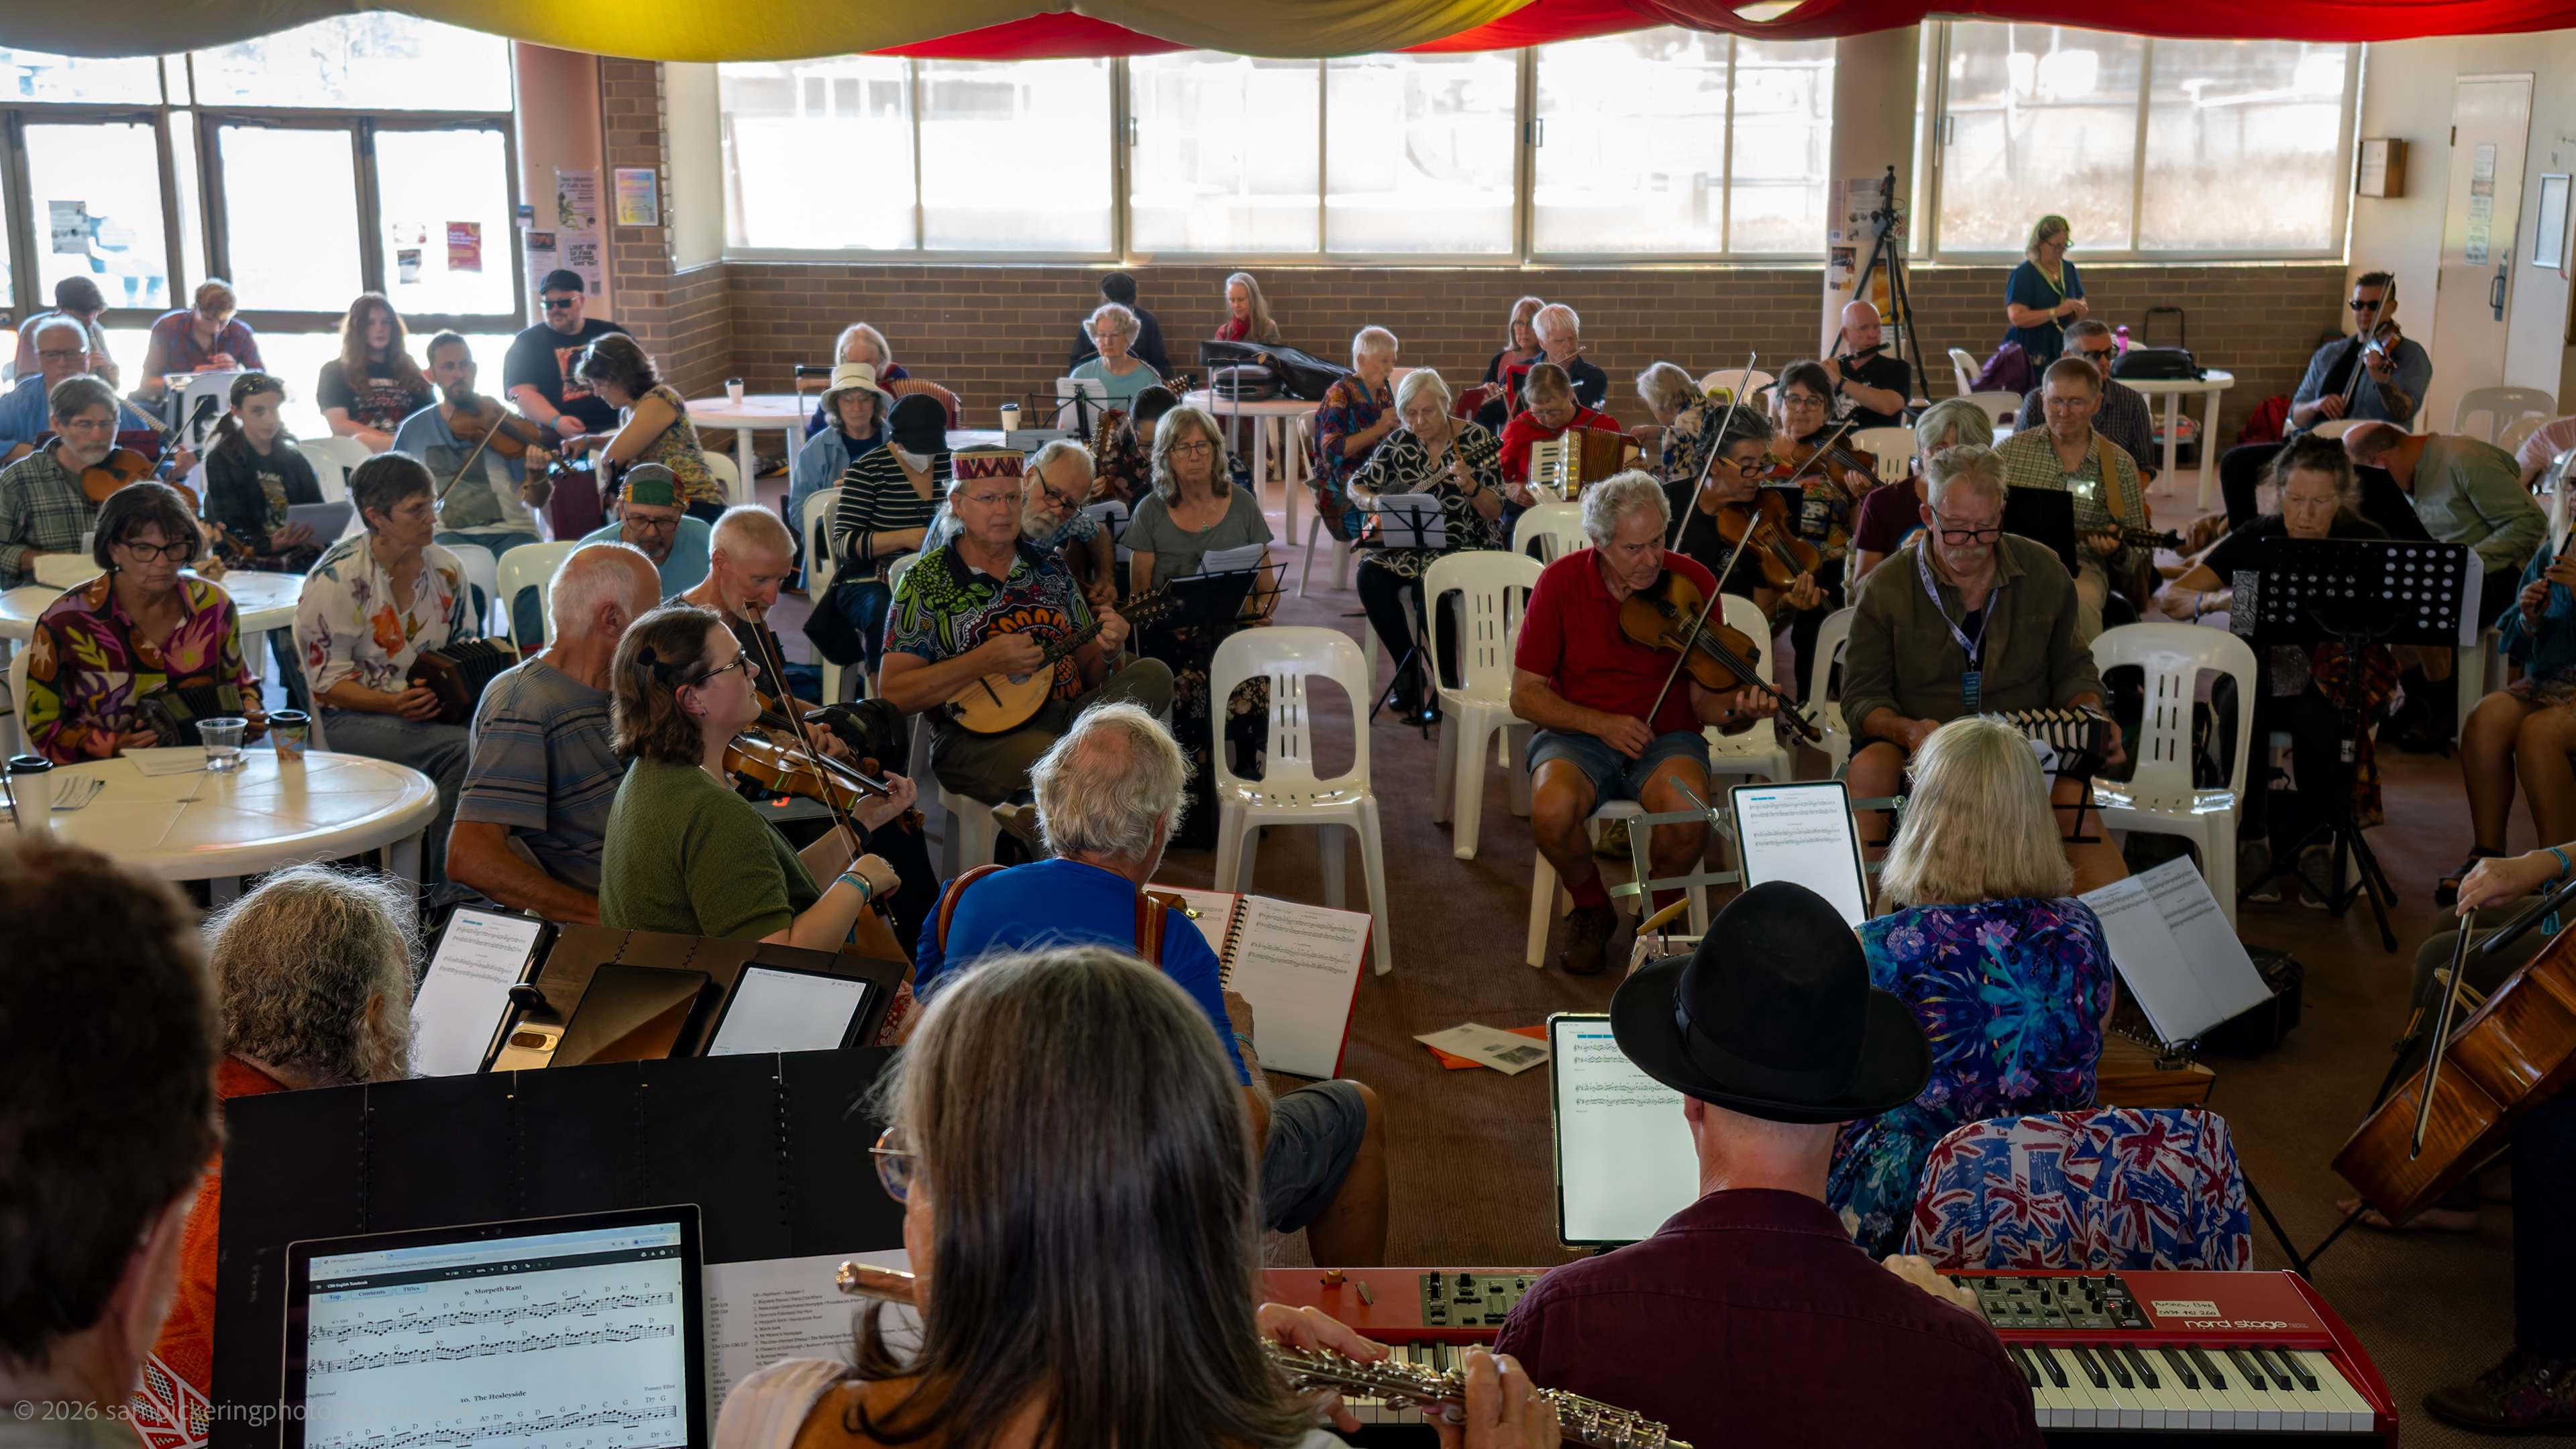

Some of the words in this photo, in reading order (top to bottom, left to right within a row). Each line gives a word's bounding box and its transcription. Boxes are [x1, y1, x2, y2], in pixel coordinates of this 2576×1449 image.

[474, 1285, 504, 1295] Morpeth
[2184, 1320, 2232, 1328] nord
[2234, 1319, 2288, 1330] stage
